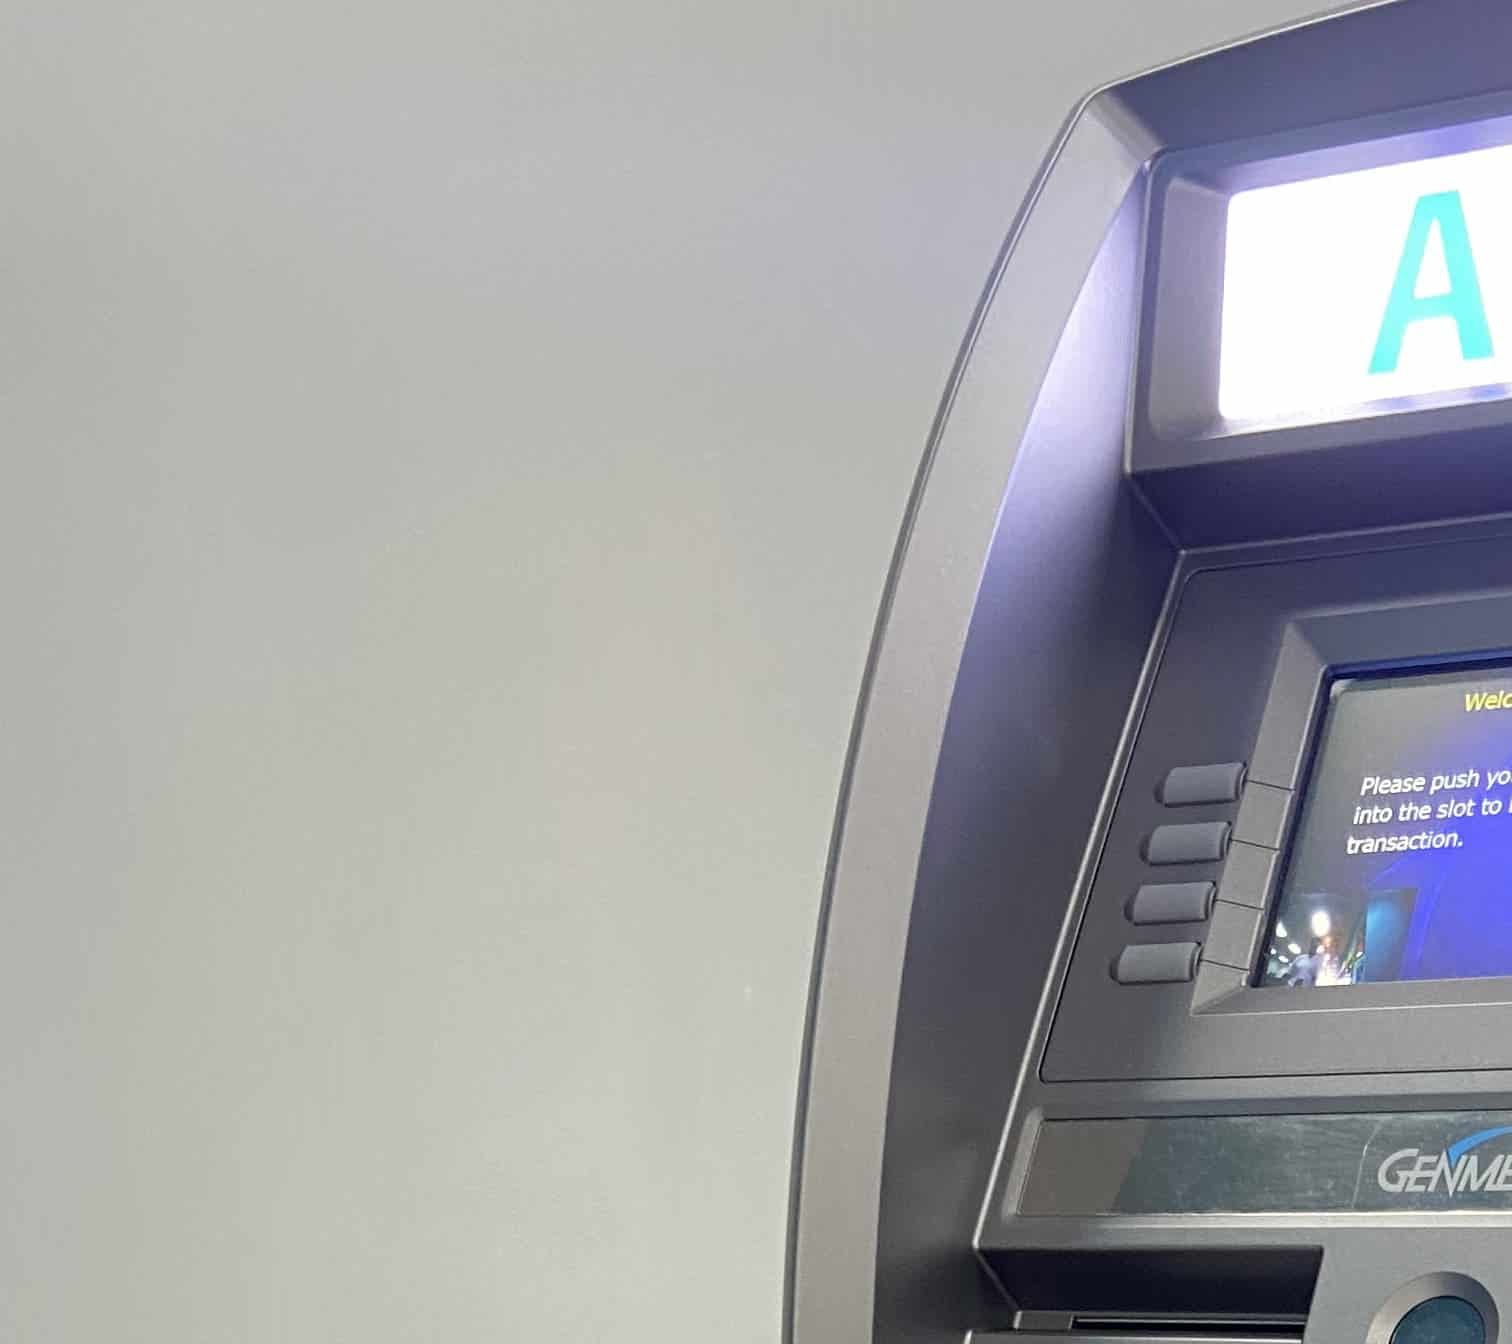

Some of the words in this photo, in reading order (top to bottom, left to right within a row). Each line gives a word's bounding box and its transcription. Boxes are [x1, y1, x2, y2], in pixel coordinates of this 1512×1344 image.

[1360, 774, 1425, 796] Please
[1429, 768, 1480, 796] push
[1352, 806, 1393, 825] into
[1399, 802, 1432, 822] the
[1438, 798, 1475, 820] slot
[1480, 797, 1501, 816] to
[1346, 831, 1463, 855] transaction.
